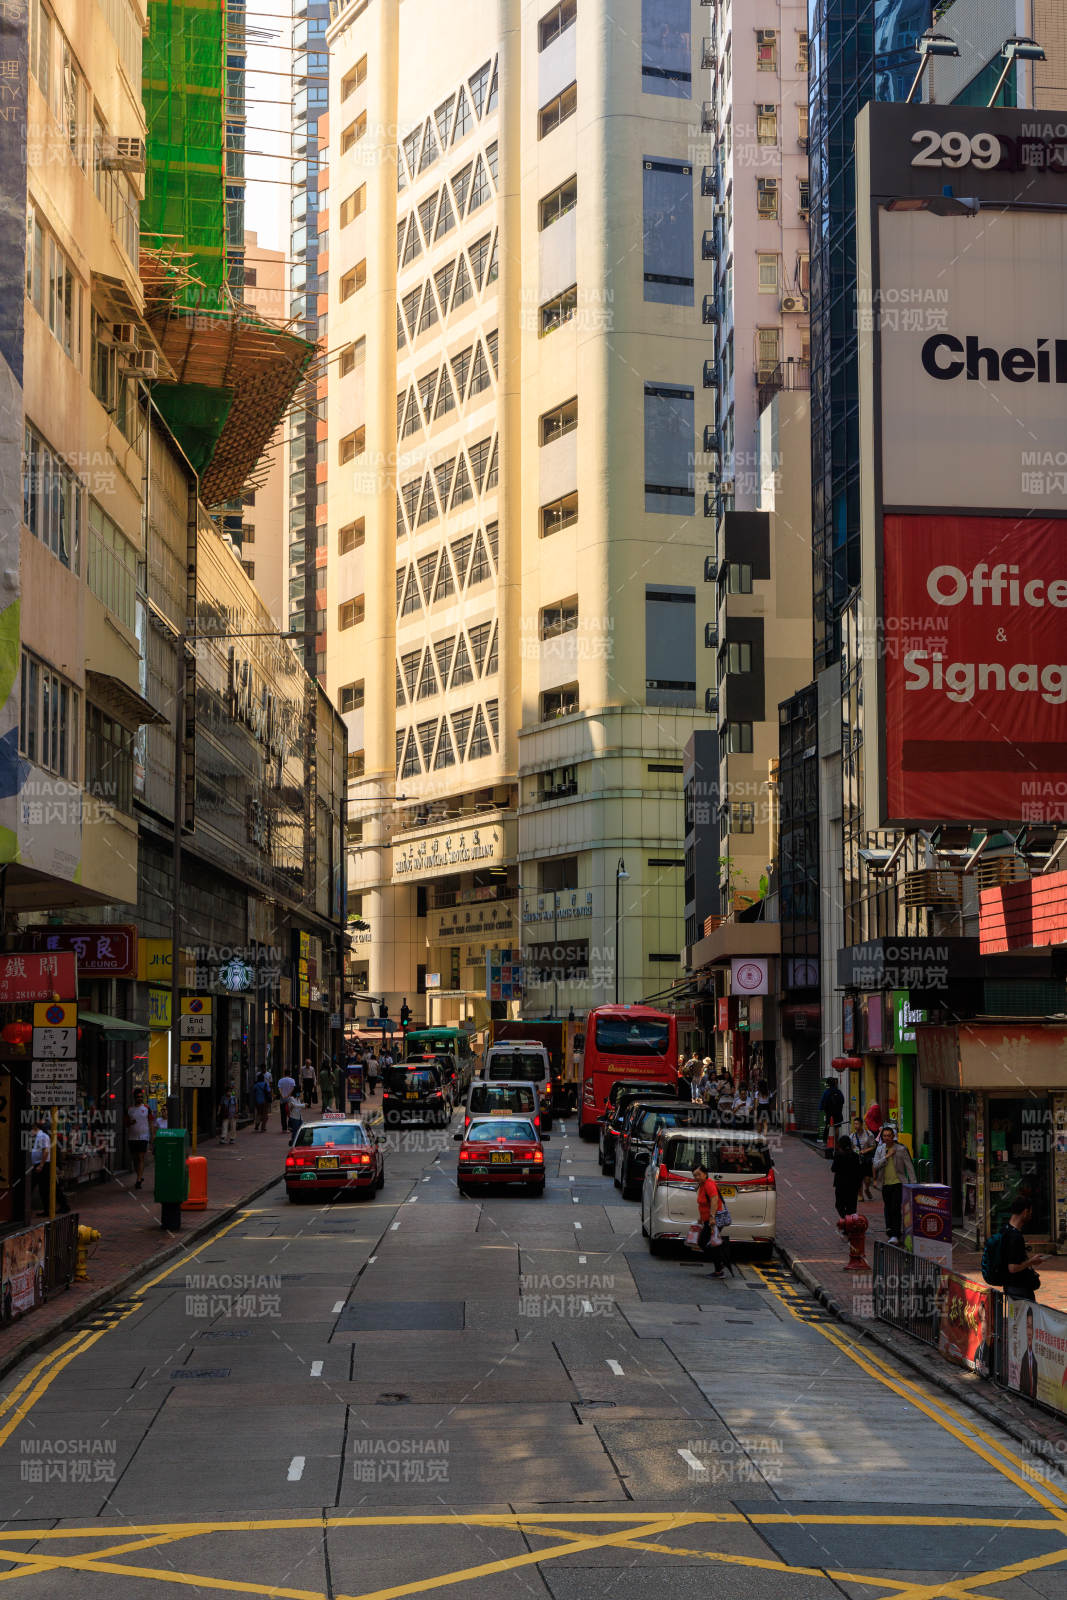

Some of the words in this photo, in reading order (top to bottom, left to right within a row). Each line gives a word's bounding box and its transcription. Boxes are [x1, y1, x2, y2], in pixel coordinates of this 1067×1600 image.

[911, 130, 1001, 168] 299
[926, 563, 1067, 608] Office
[995, 627, 1008, 642] &
[903, 650, 1067, 705] Signag
[85, 960, 118, 968] LEUNG
[61, 1030, 69, 1040] 7
[61, 1046, 69, 1056] 7
[199, 1078, 205, 1086] 7
